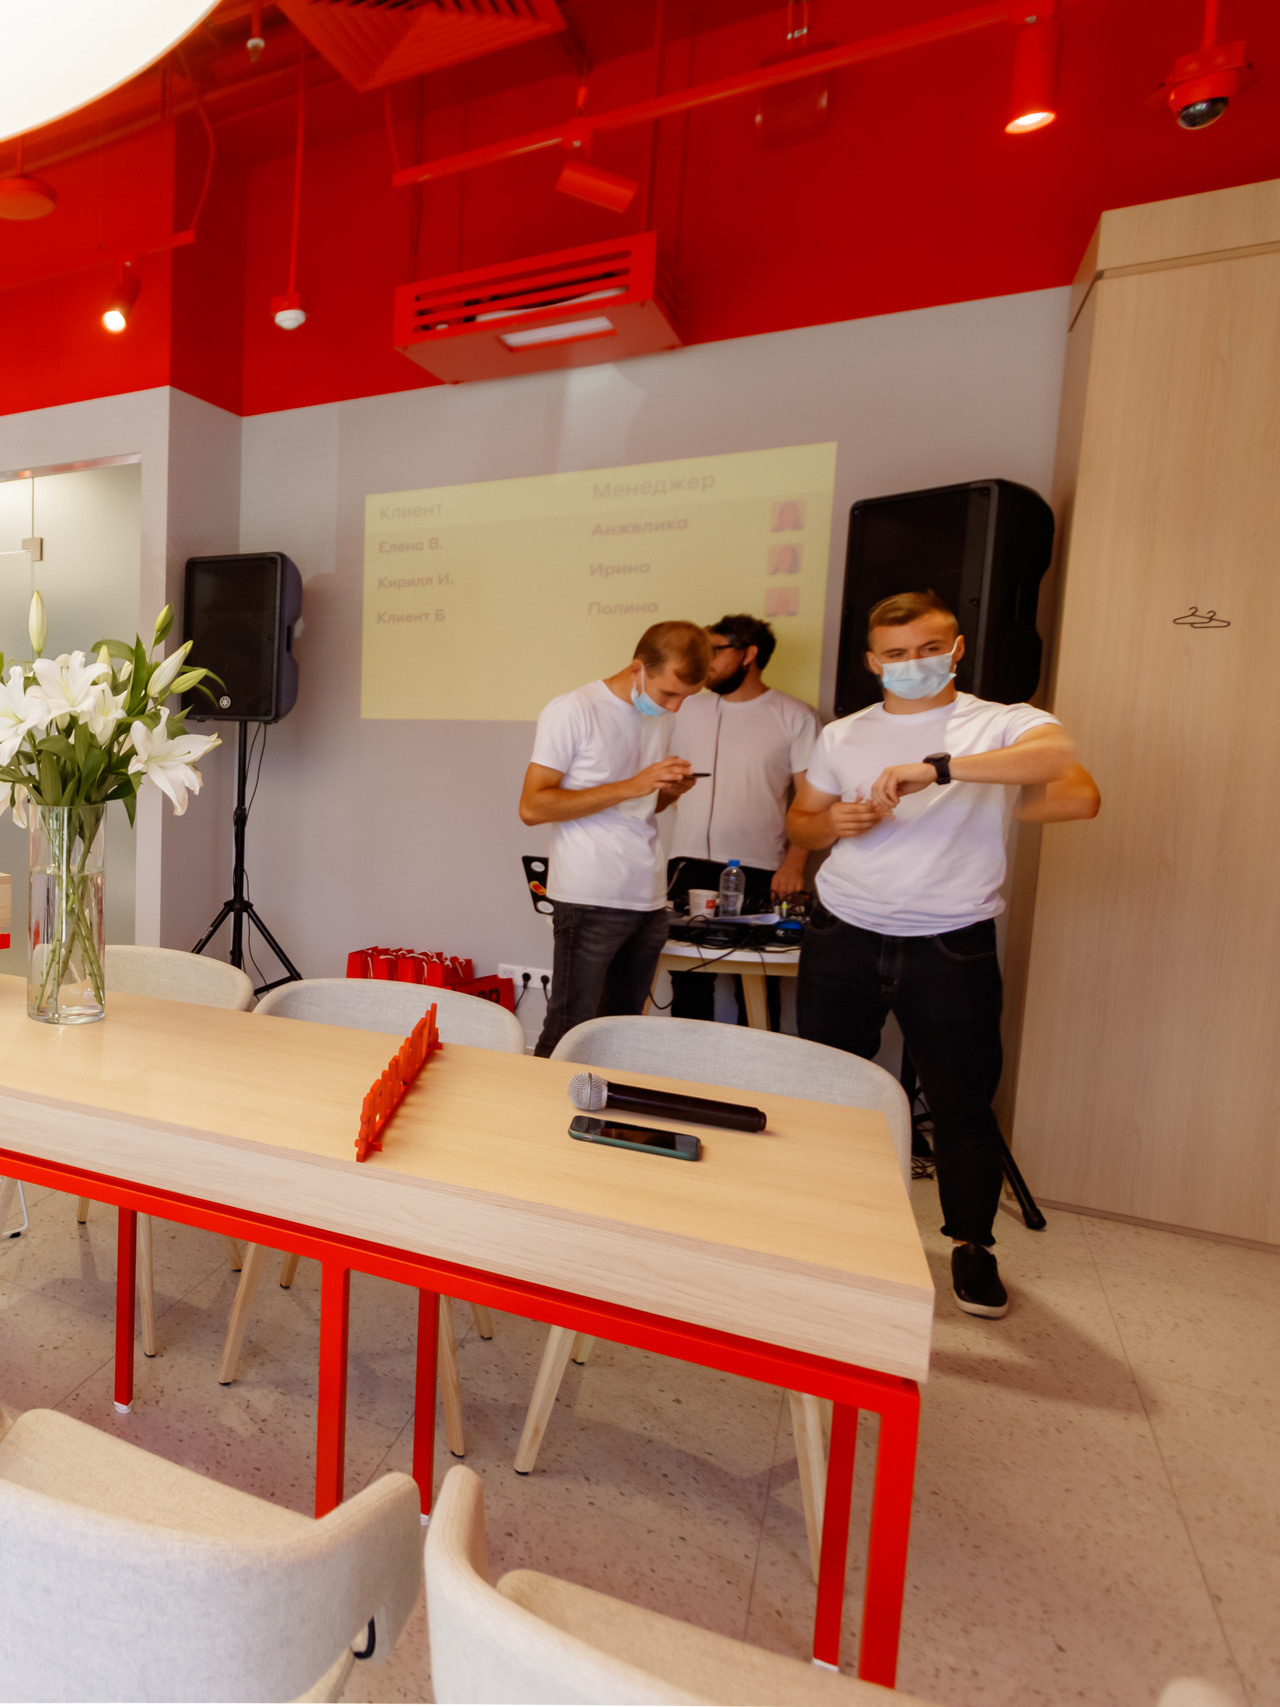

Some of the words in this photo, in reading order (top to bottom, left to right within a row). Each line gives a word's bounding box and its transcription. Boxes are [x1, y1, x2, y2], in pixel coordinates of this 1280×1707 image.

[592, 474, 716, 499] Менеджер
[379, 502, 444, 520] Клиент
[591, 518, 689, 537] Анжелика
[378, 539, 424, 554] Елена
[428, 537, 444, 550] В.
[589, 562, 651, 579] Ирина
[377, 575, 433, 592] Кирилл
[438, 572, 454, 586] И.
[376, 610, 431, 625] Клиент
[435, 608, 446, 622] Б
[587, 601, 659, 616] Полина
